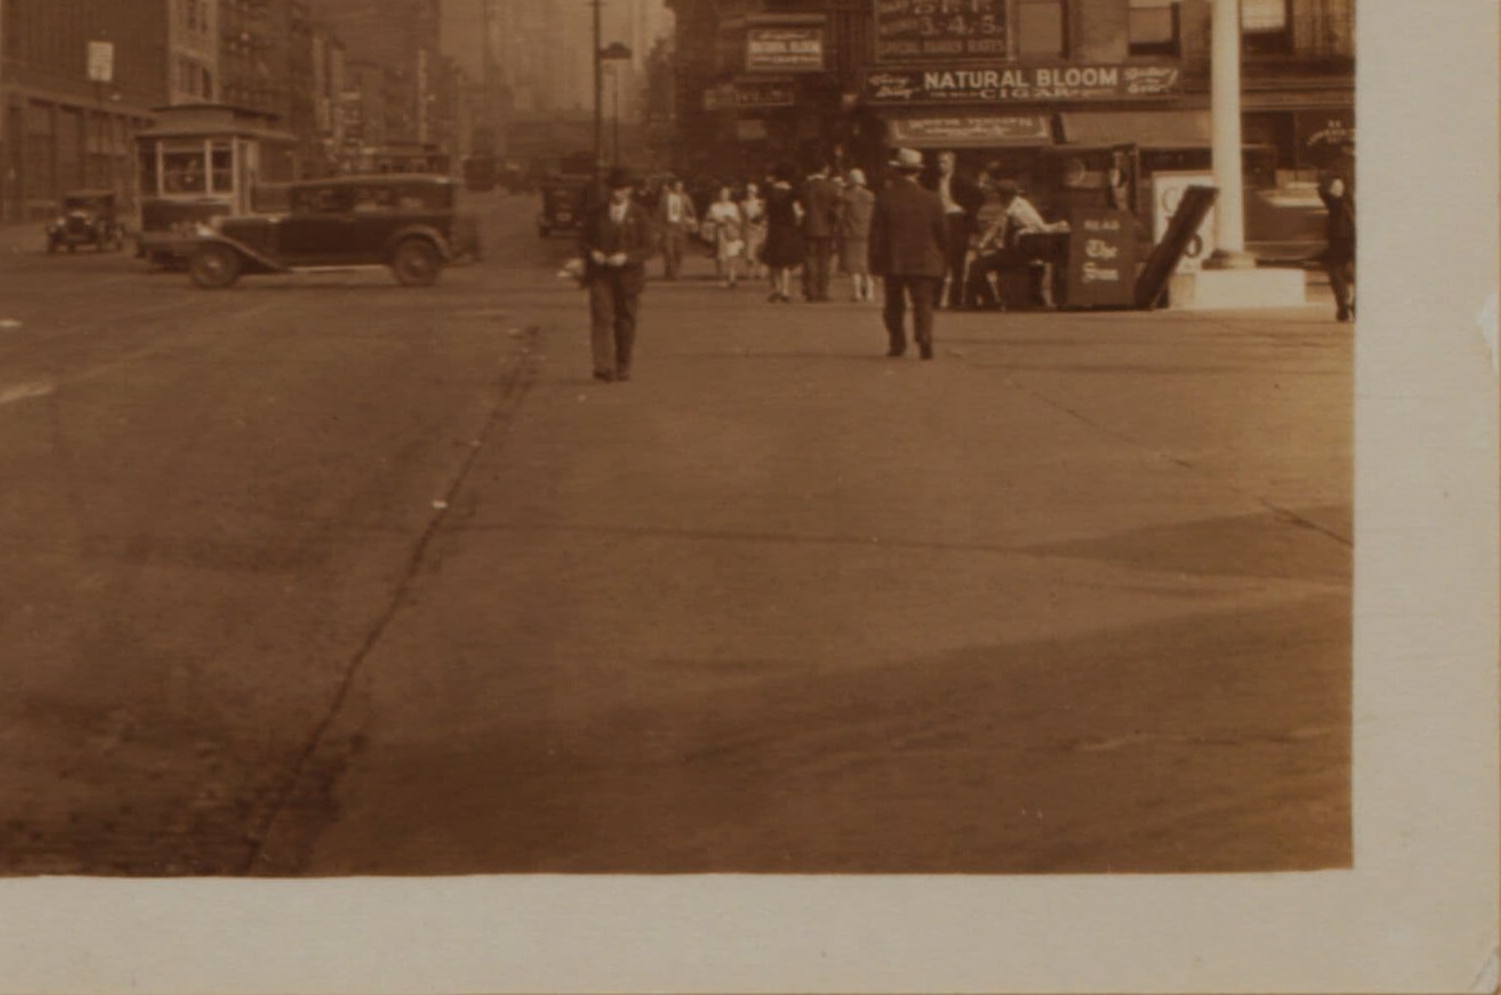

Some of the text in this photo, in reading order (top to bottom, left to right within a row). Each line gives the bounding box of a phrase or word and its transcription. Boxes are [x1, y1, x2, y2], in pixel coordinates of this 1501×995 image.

[923, 68, 1031, 90] NATURAL
[1036, 67, 1118, 88] BLOOM
[1083, 219, 1120, 231] READ
